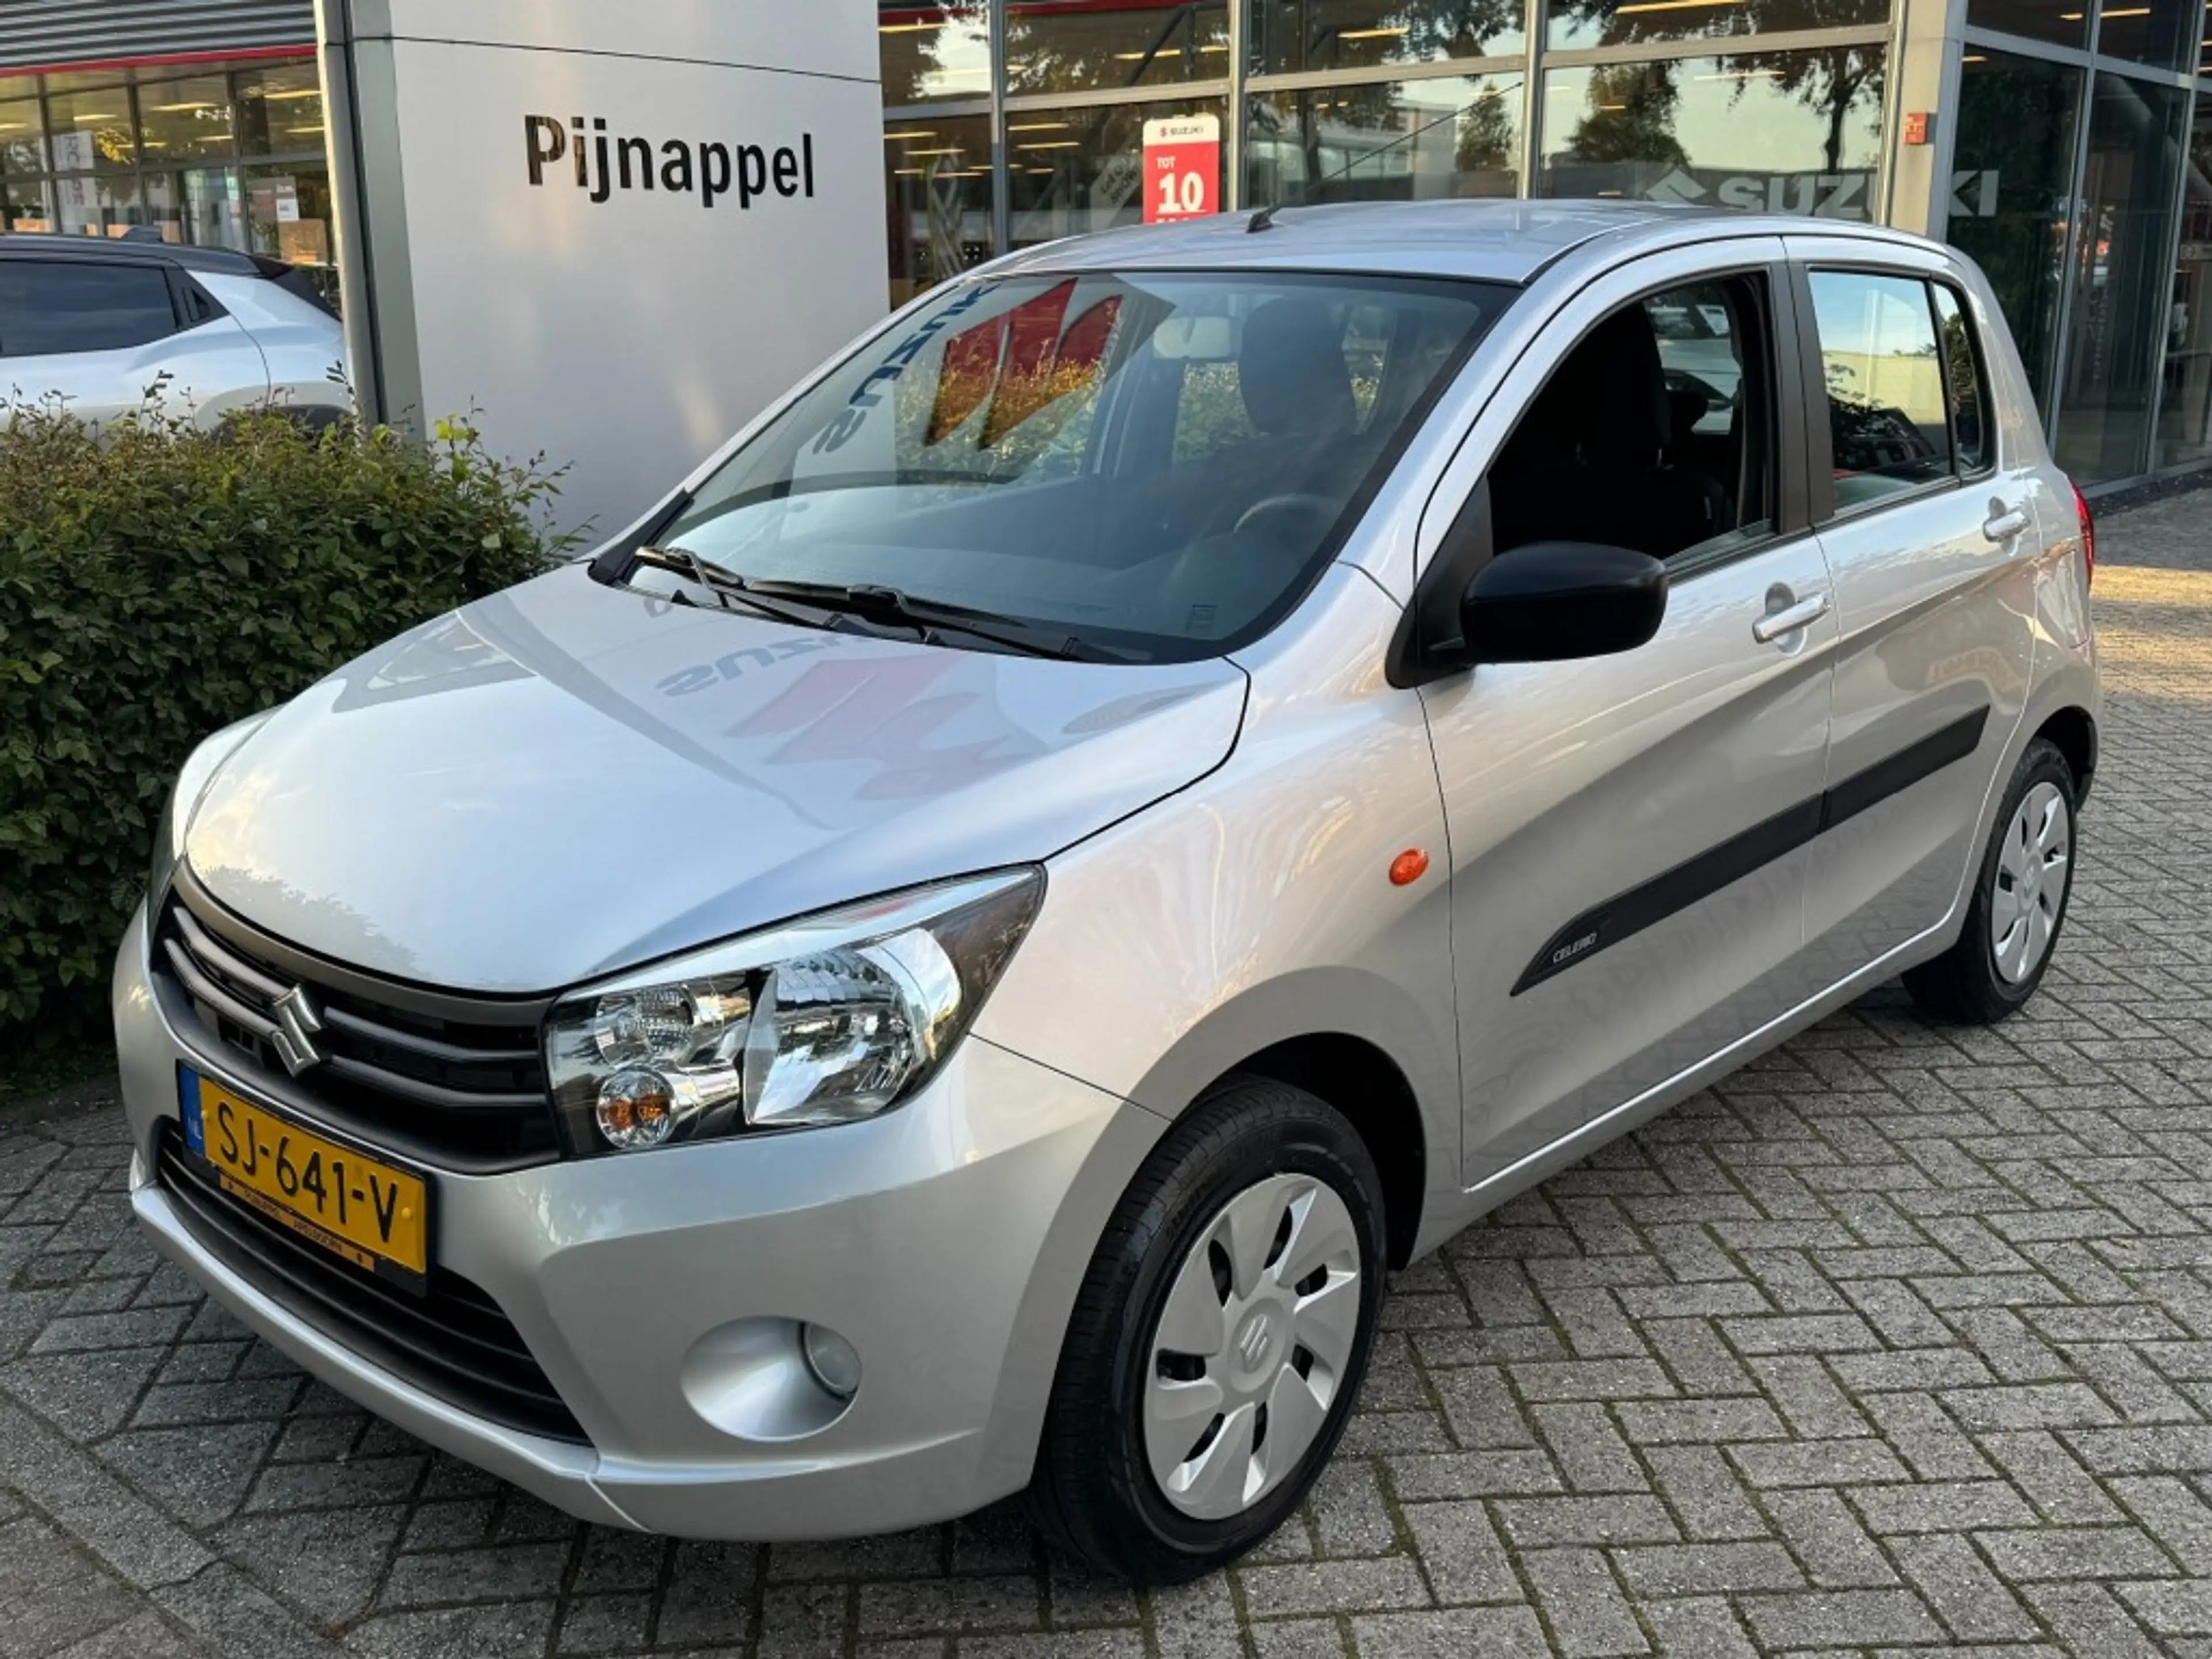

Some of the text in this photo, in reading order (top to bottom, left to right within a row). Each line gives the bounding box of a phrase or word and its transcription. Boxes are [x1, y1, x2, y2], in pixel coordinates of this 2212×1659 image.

[525, 115, 814, 209] Pijnappel
[1156, 156, 1176, 169] TOT
[1158, 171, 1205, 215] 10
[218, 1101, 398, 1243] SJ-641-V
